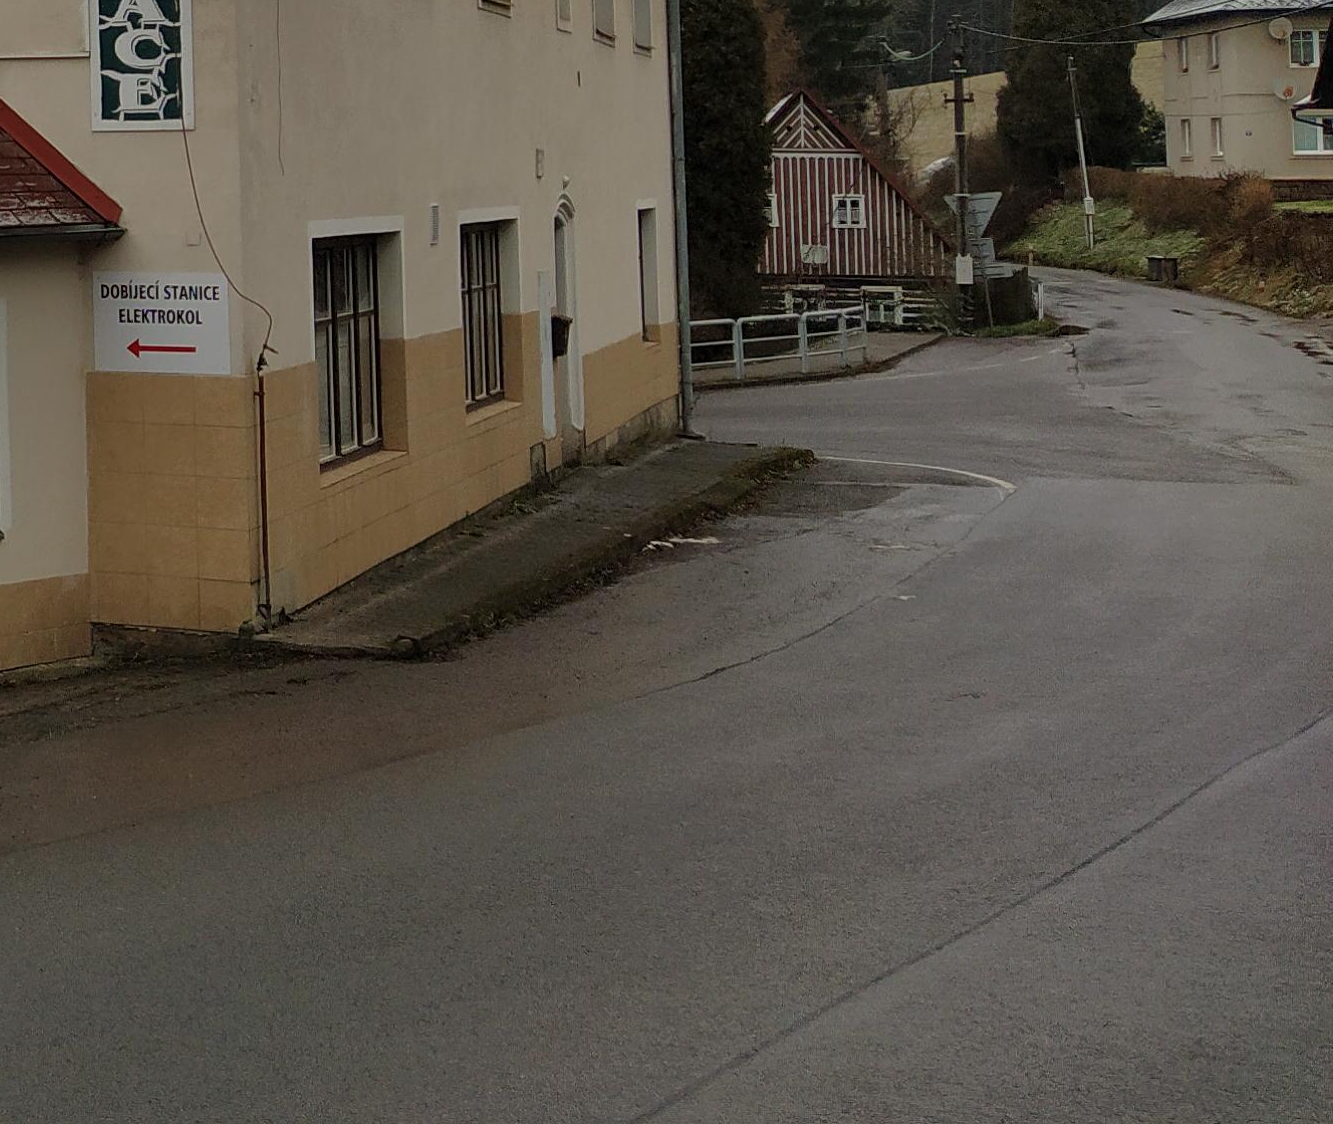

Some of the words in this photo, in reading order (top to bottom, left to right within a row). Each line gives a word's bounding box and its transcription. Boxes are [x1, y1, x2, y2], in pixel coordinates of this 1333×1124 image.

[100, 279, 160, 300] DOBÍJECÍ
[163, 284, 220, 301] STANICE
[118, 308, 203, 325] ELEKTROKOL
